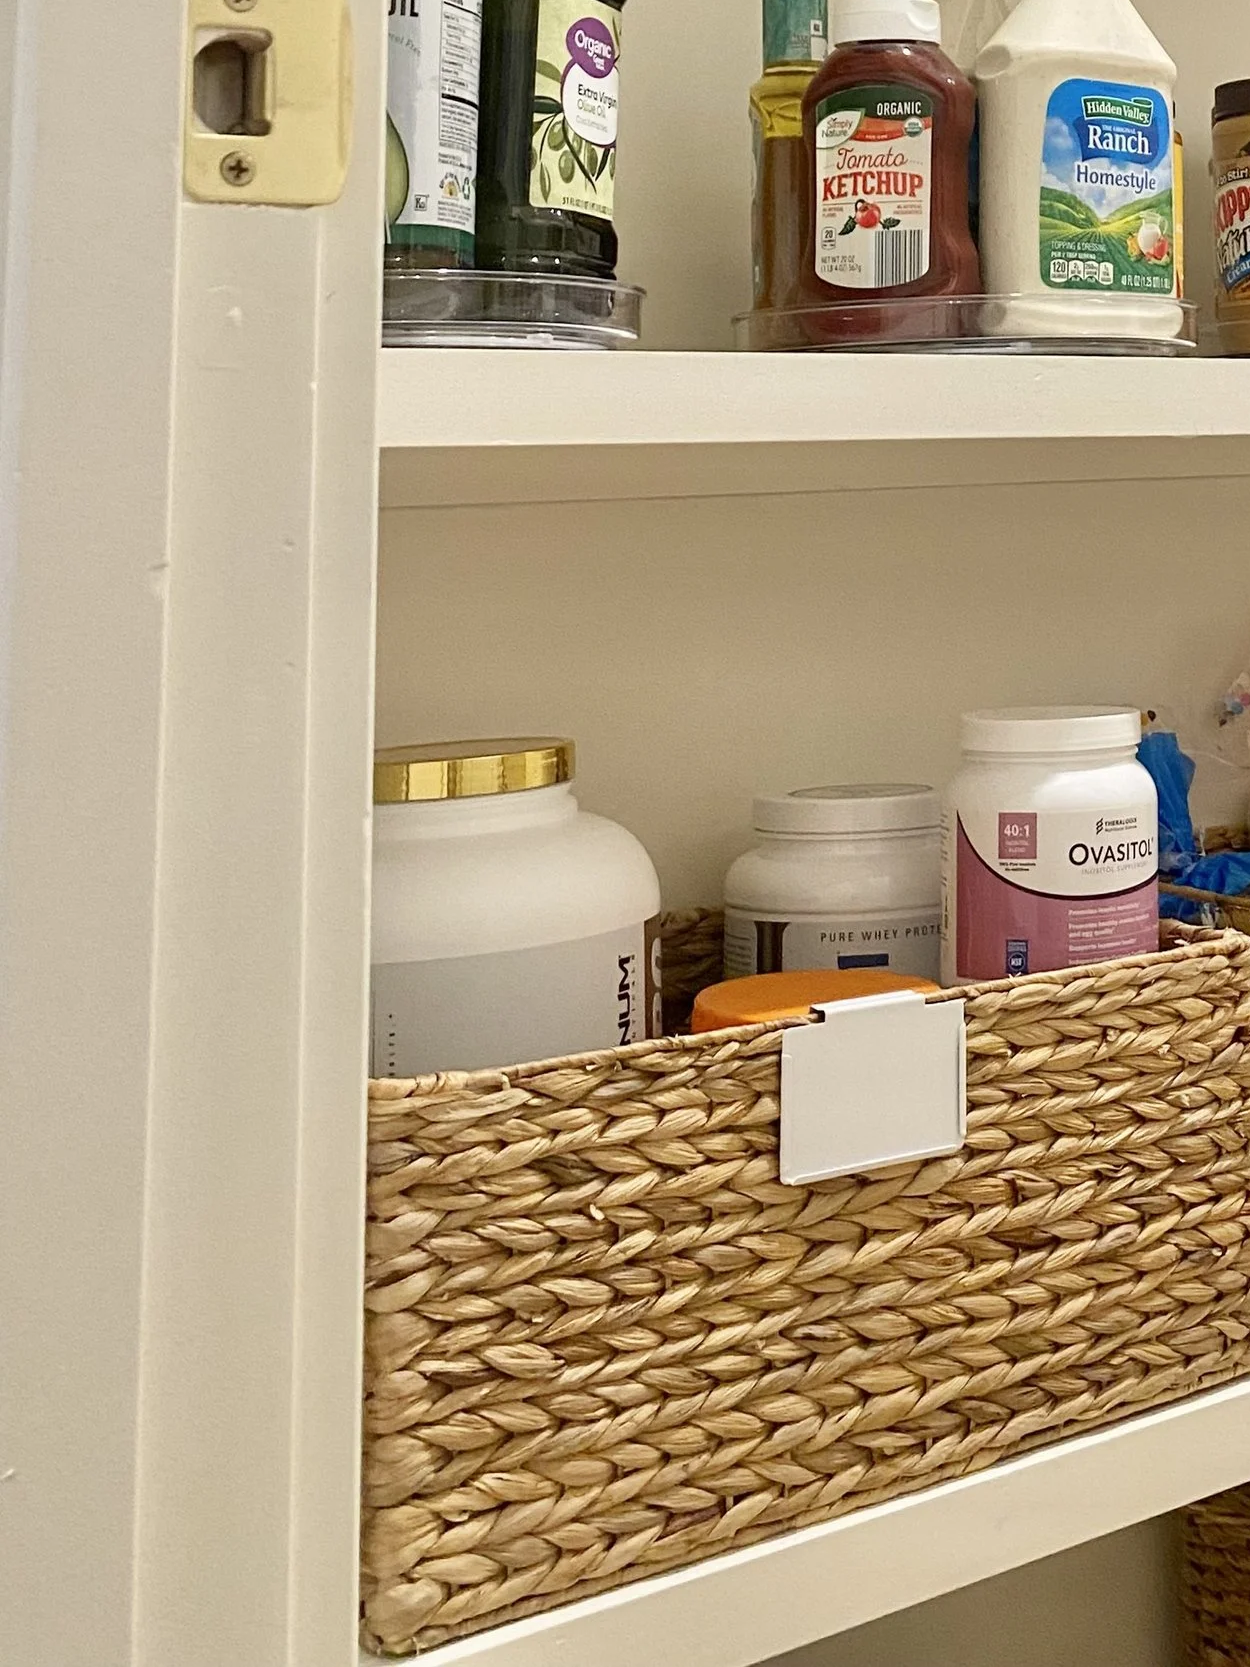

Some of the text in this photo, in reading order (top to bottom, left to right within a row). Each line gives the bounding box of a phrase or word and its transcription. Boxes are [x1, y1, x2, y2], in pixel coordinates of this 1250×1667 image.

[574, 29, 612, 59] Organic
[577, 83, 618, 110] Extra Virgin
[576, 98, 607, 119] Olive Oil
[876, 101, 923, 117] ORGANIC
[1086, 101, 1151, 124] Hidden Valley
[821, 127, 850, 139] Nature
[826, 117, 854, 133] Simply
[1087, 124, 1152, 156] Ranch
[836, 147, 909, 171] Tomato
[822, 170, 924, 202] KETCHUP
[1076, 164, 1157, 194] Homestyle
[824, 228, 834, 239] 20
[1051, 240, 1077, 251] TOPPING
[1081, 241, 1107, 253] DRESSING
[821, 255, 830, 264] NET
[830, 255, 839, 264] WT
[1052, 260, 1066, 273] 120
[1003, 824, 1031, 838] 40:1
[1068, 838, 1153, 866] OVASITOL
[1081, 866, 1115, 875] INOSITOL
[820, 931, 854, 943] PURE
[861, 928, 899, 941] WHEY
[1010, 957, 1023, 967] NSF
